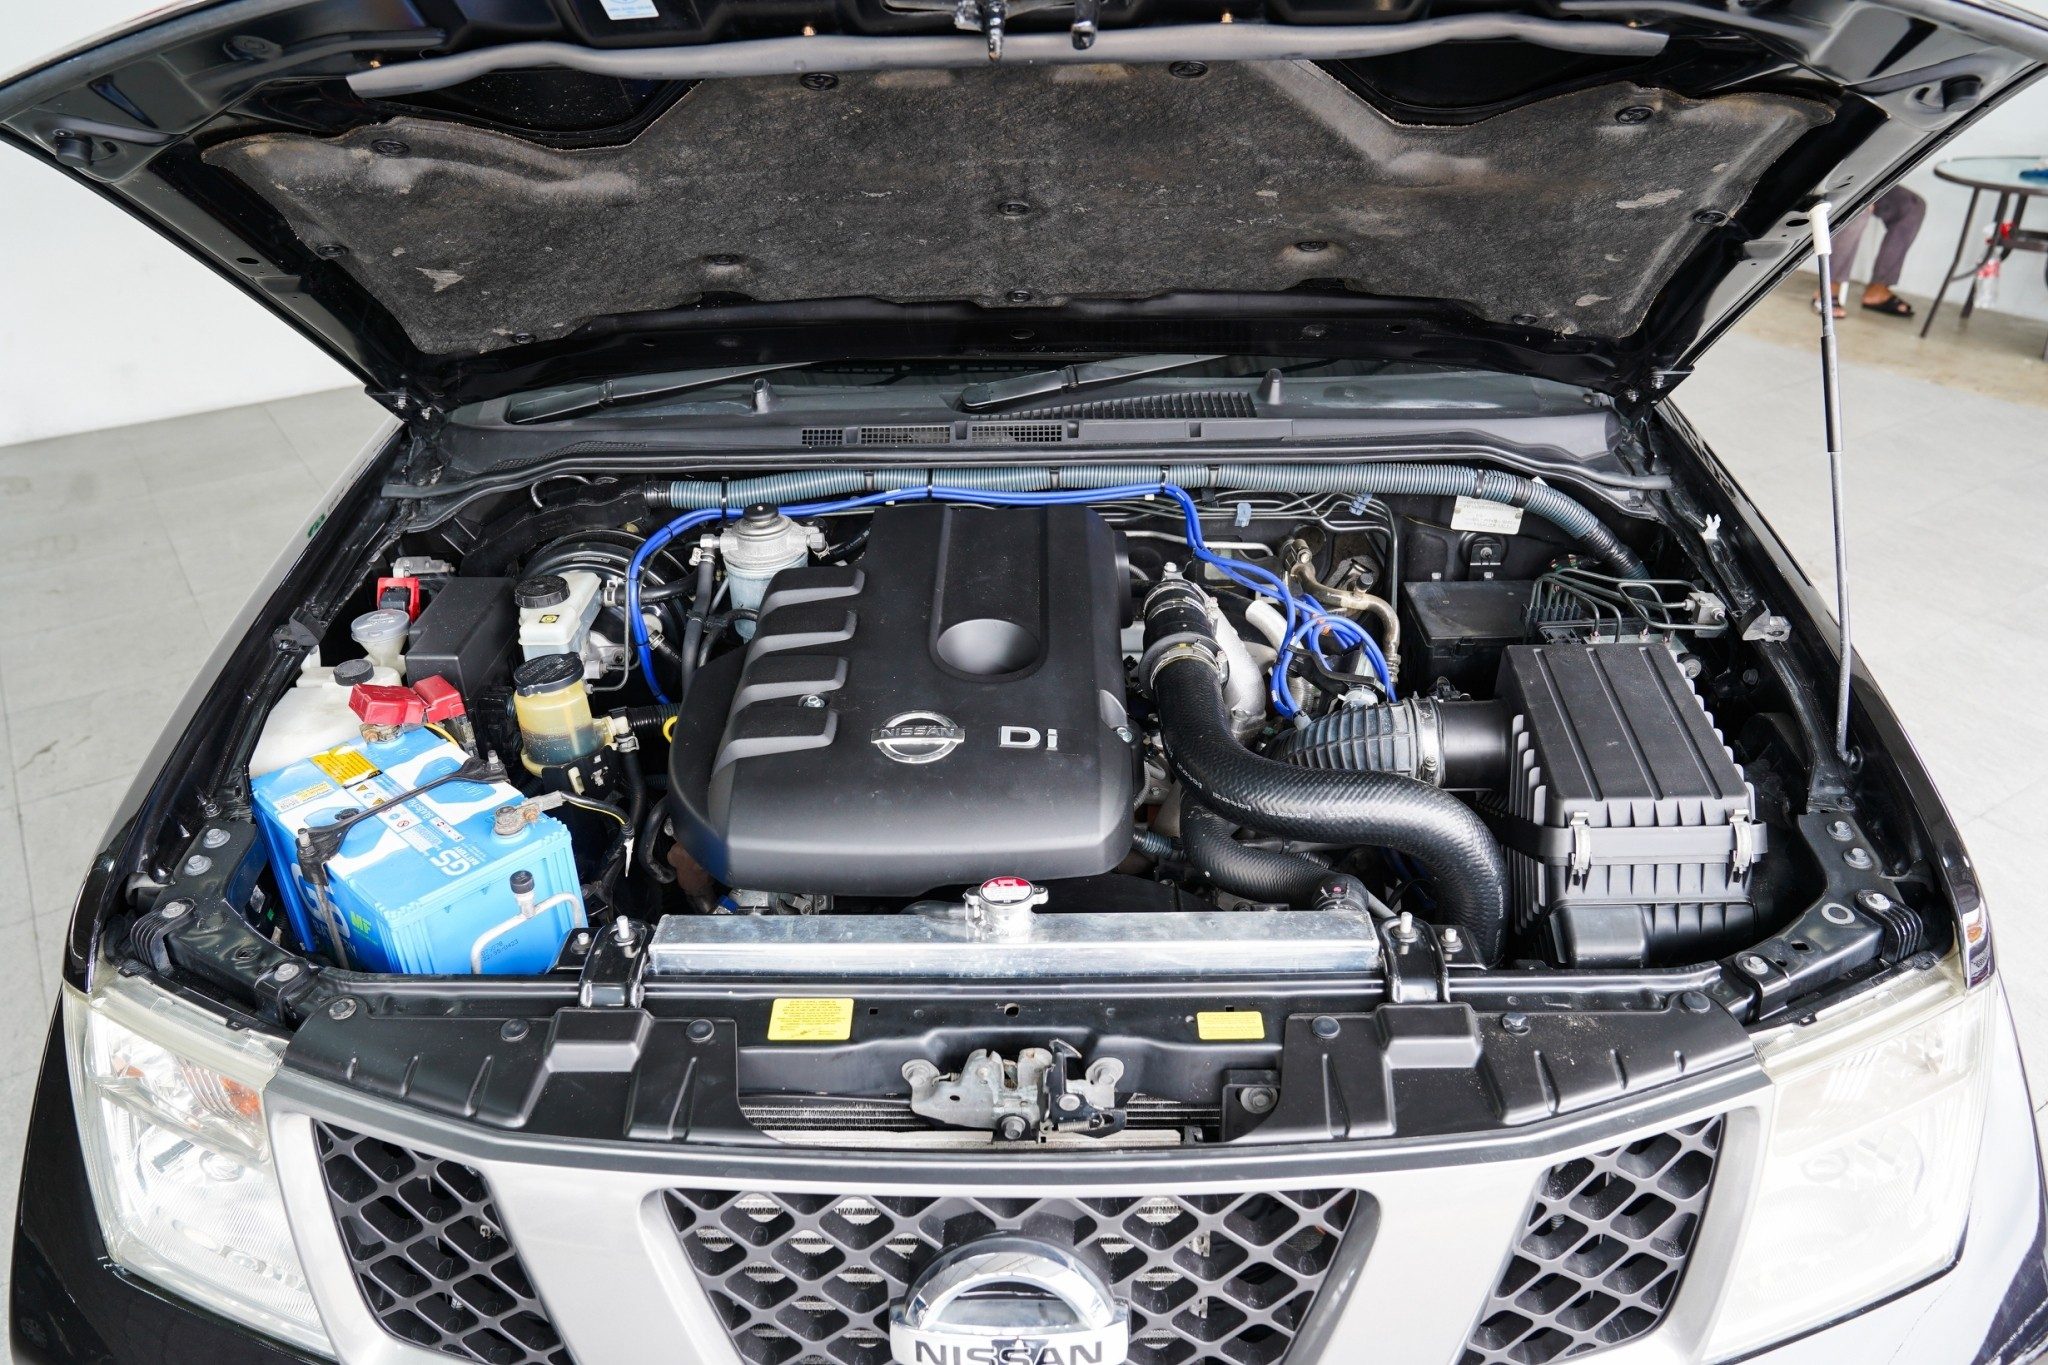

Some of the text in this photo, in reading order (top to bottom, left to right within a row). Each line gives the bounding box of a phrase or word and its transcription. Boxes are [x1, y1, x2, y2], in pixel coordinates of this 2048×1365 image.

[880, 726, 955, 738] NISSAN
[998, 725, 1059, 751] Di
[429, 849, 472, 876] GS
[349, 910, 372, 935] MF
[915, 1341, 1102, 1365] NISSAN
